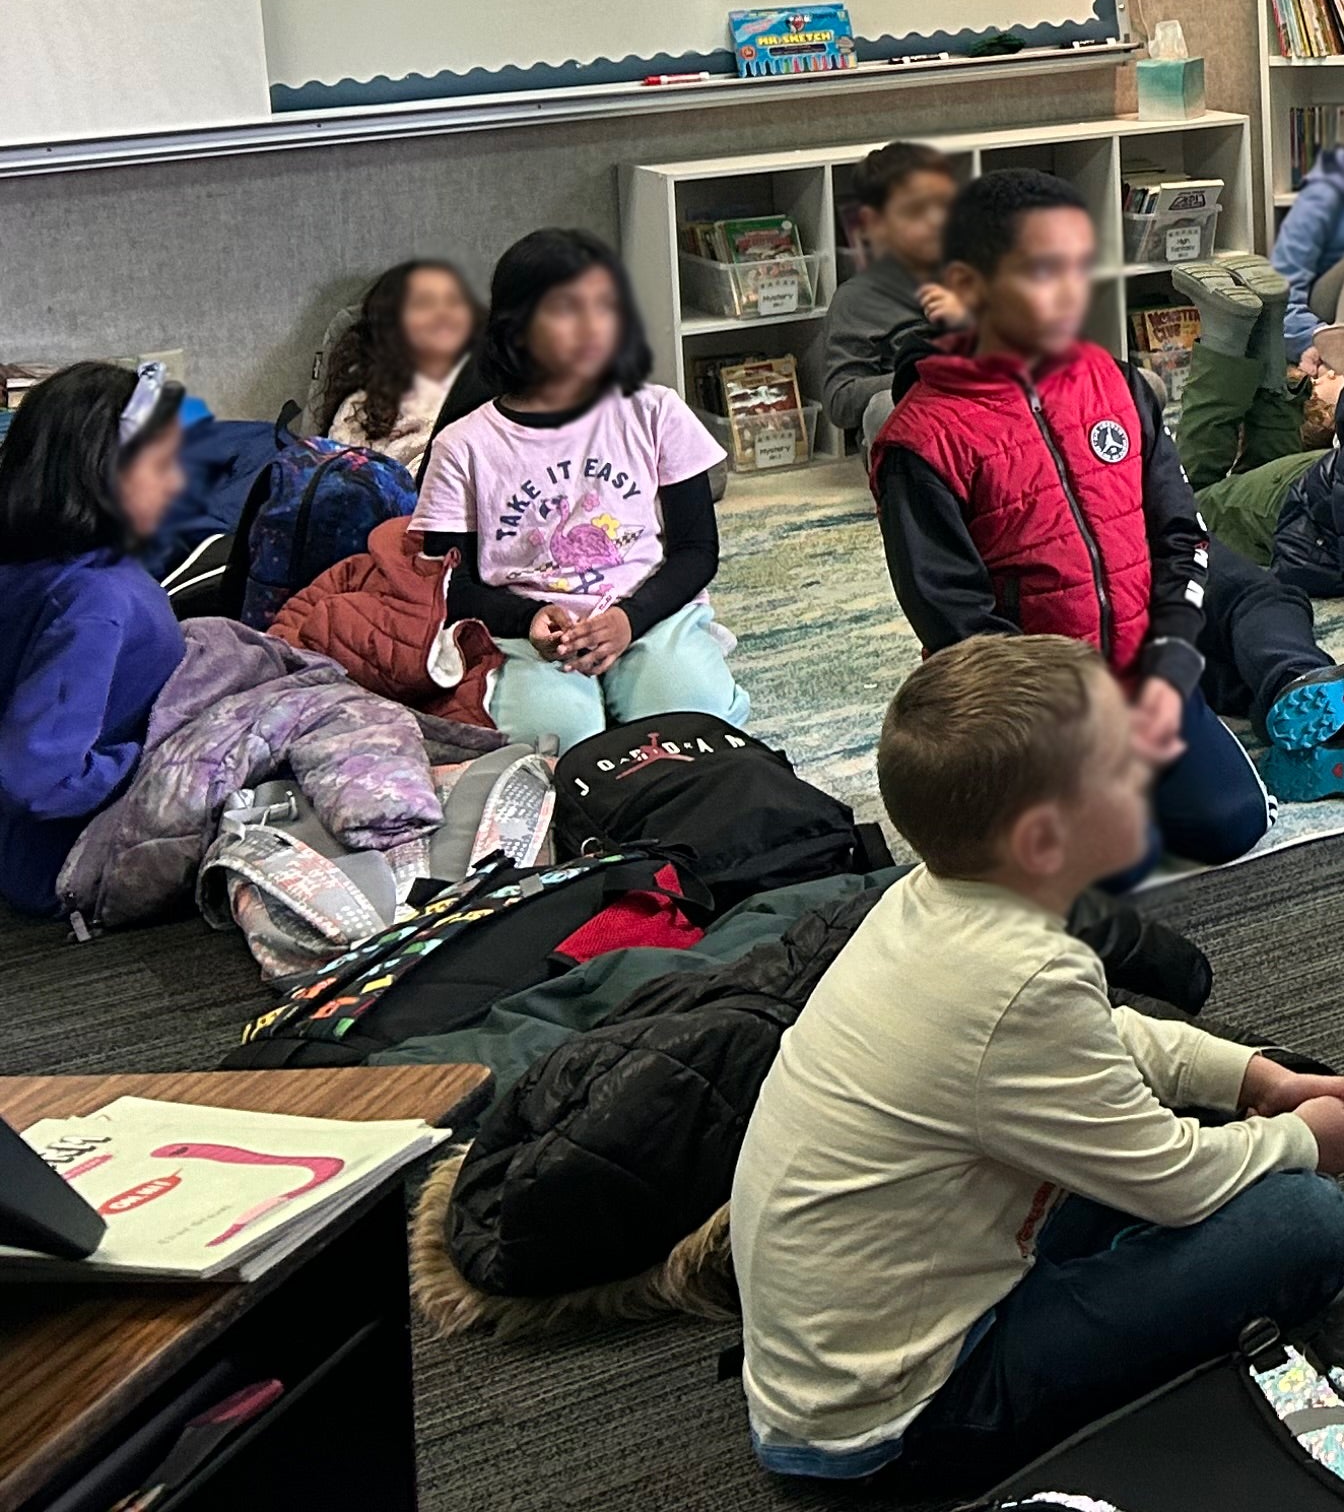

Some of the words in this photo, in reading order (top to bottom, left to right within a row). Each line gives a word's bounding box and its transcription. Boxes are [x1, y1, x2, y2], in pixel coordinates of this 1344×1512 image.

[762, 291, 794, 303] Mystery
[760, 445, 791, 456] Mystery
[496, 480, 541, 542] TAKE
[546, 460, 572, 485] IT
[584, 458, 642, 501] EASY
